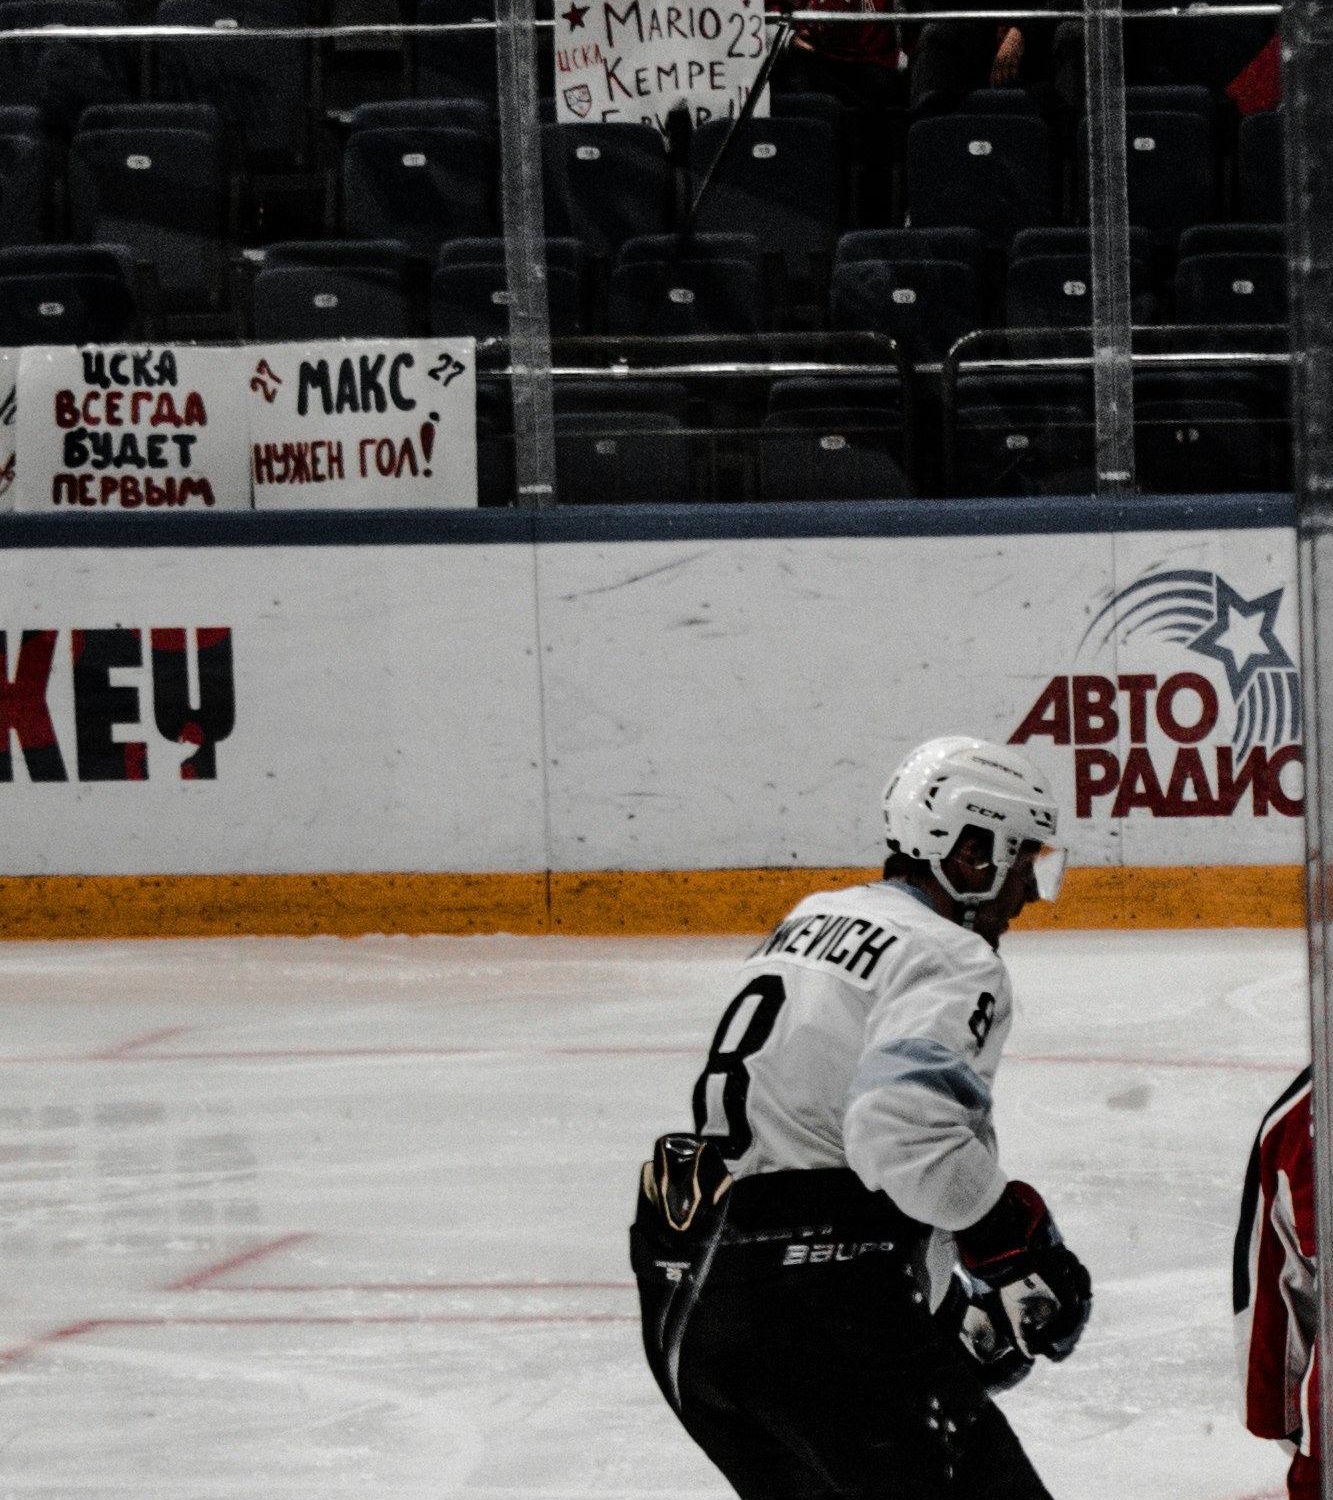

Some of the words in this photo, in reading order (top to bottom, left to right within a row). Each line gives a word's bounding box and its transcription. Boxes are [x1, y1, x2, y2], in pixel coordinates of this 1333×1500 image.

[727, 13, 764, 58] 23
[603, 55, 726, 101] KEMPE
[81, 350, 179, 388] ЦСКА
[250, 358, 283, 403] 27
[427, 352, 467, 387] 27
[54, 390, 208, 428] ВСЕГДА
[63, 429, 197, 469] БУДЕТ
[253, 440, 345, 485] НУЖЕН
[358, 420, 436, 480] ГОЛ!
[52, 473, 216, 507] ПЕРВЫМ
[1007, 671, 1220, 745] АВТО
[1075, 744, 1306, 819] РАДИО
